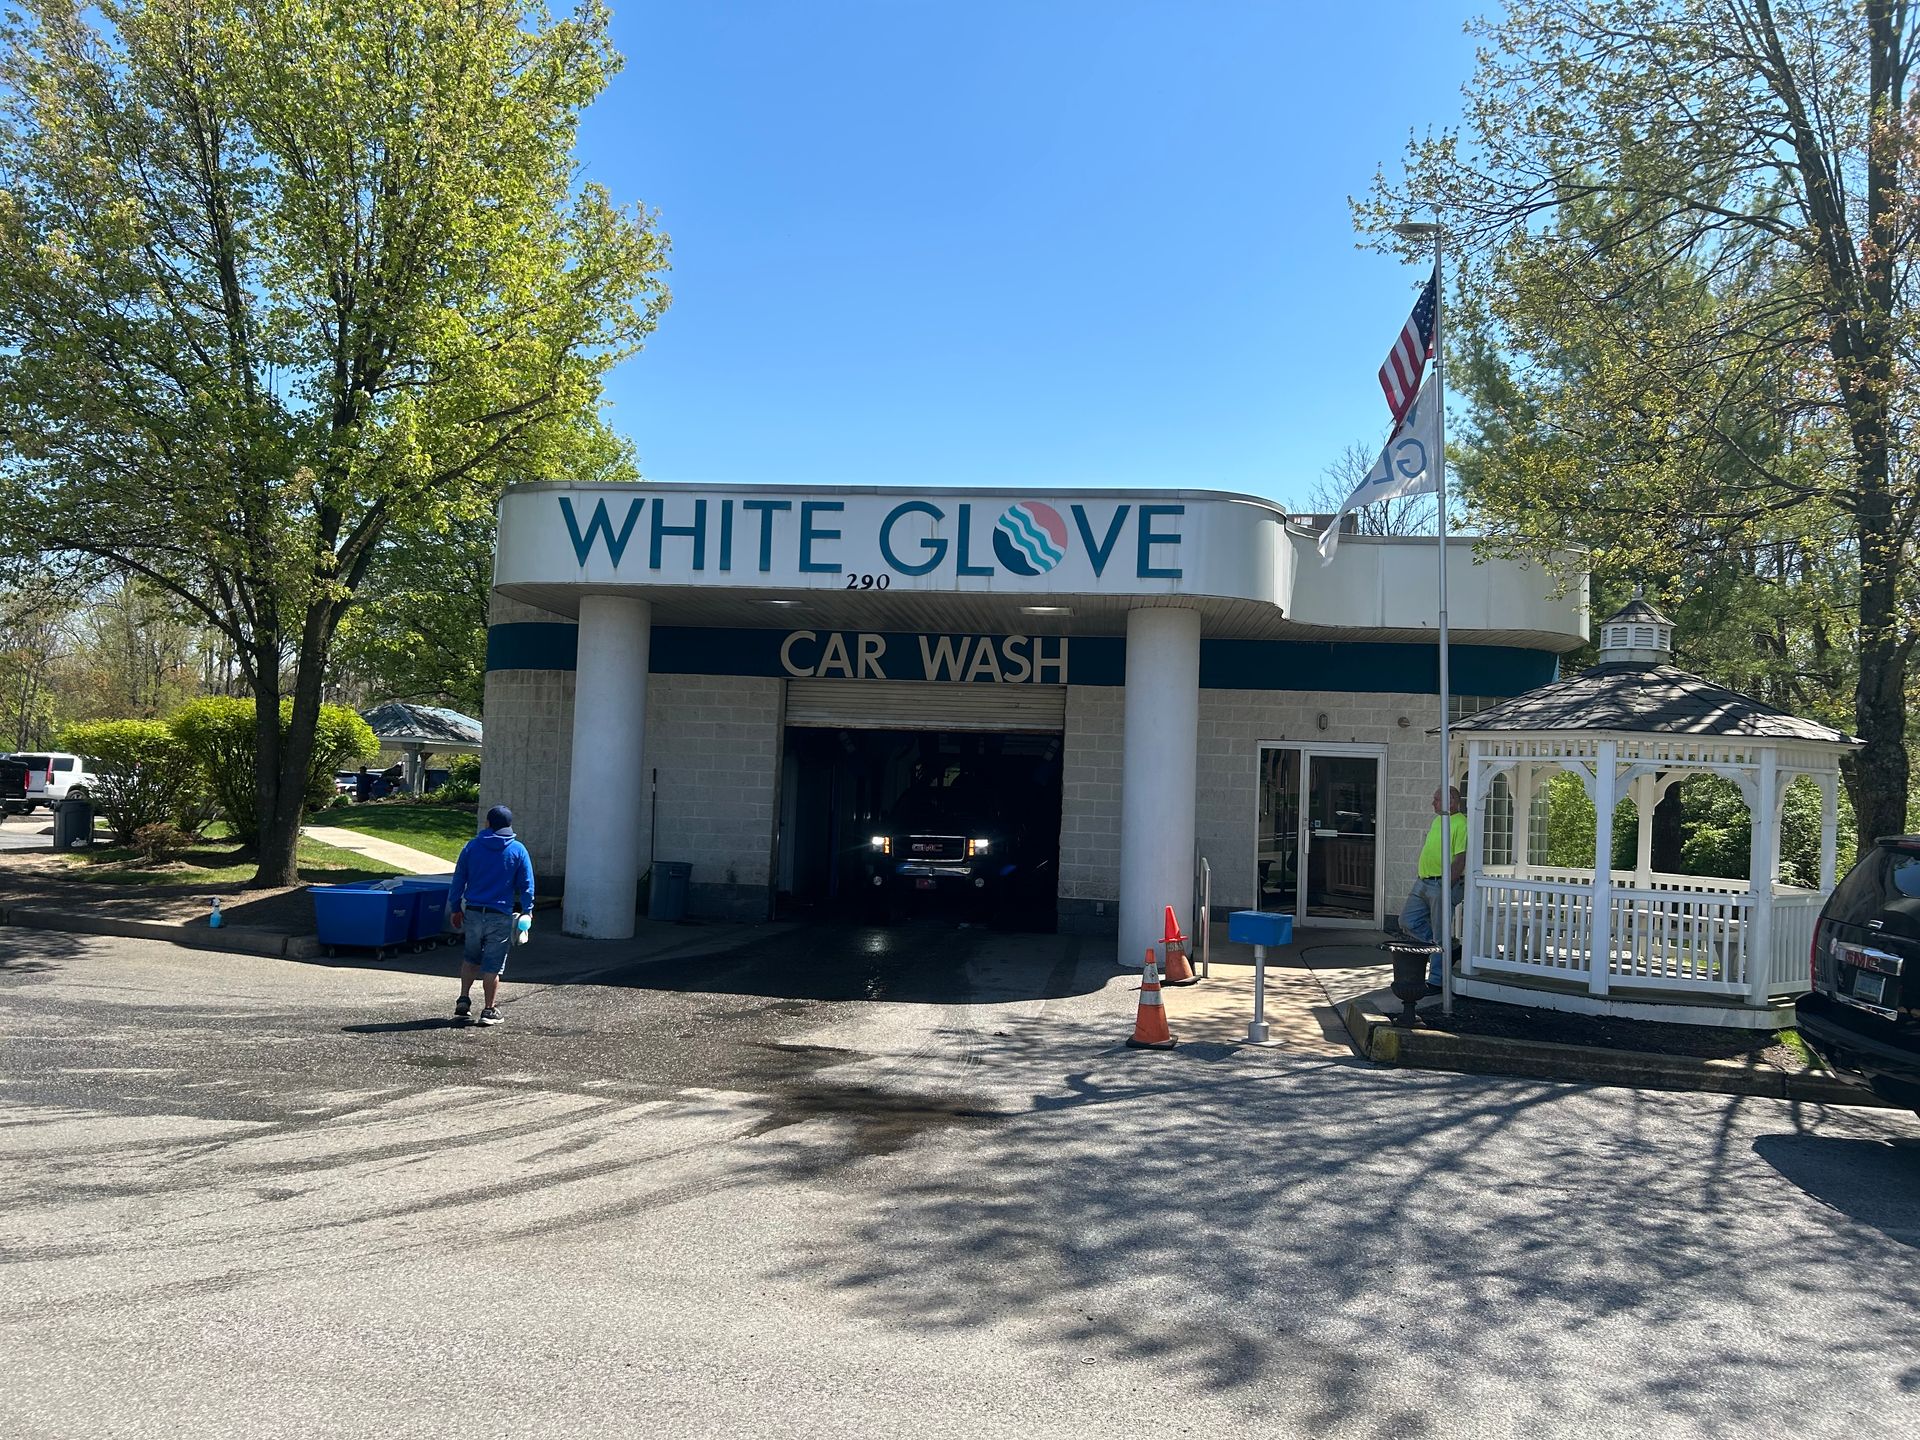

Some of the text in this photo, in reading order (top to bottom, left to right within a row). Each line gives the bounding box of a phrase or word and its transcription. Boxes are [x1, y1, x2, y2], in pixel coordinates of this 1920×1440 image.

[558, 497, 1185, 578] WHITE GLOVE
[846, 573, 890, 590] 290
[781, 631, 1069, 684] CAR WASH
[1846, 951, 1881, 972] GMC
